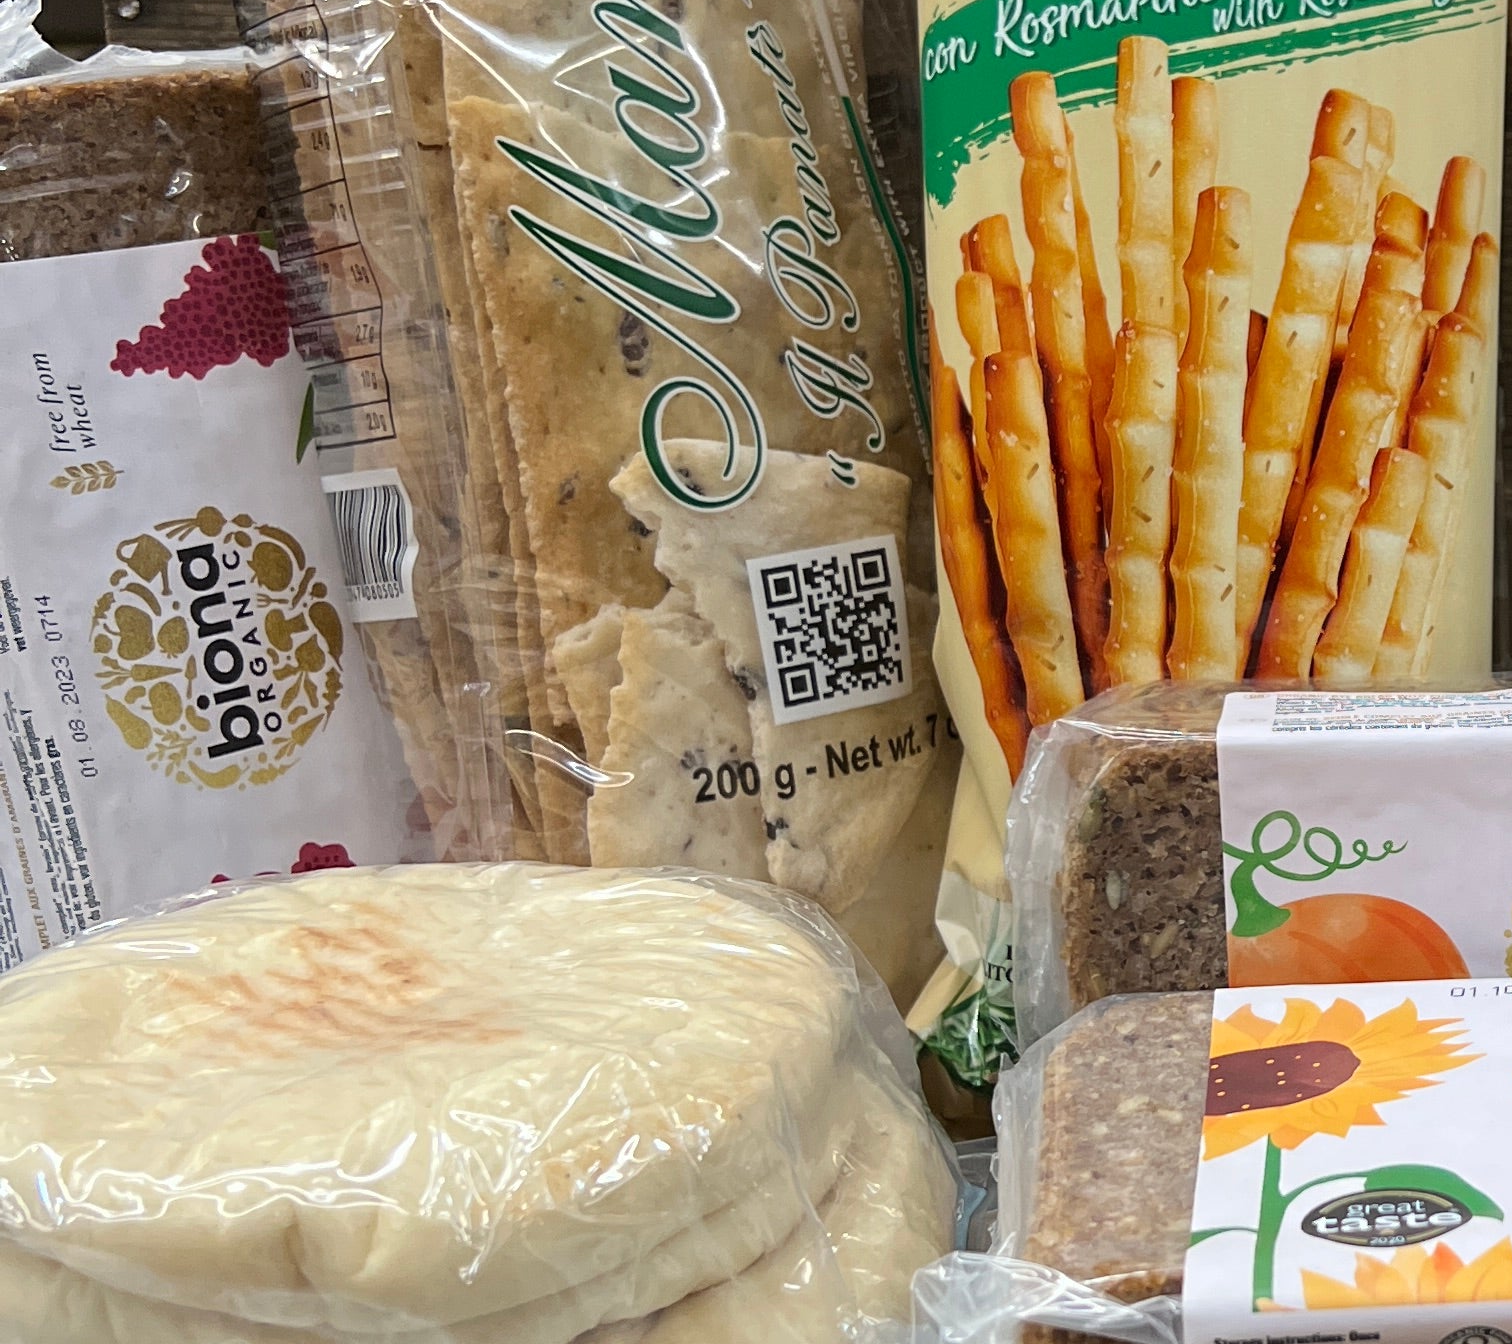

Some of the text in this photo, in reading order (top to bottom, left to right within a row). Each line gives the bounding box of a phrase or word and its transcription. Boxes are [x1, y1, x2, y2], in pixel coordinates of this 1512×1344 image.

[925, 34, 978, 83] con
[32, 352, 73, 454] free from
[65, 383, 97, 449] wheat
[38, 594, 64, 642] 0714
[178, 541, 264, 761] biona
[224, 550, 281, 734] ORGANIC
[692, 758, 761, 803] 200
[775, 764, 796, 801] g
[825, 733, 883, 779] Net
[888, 726, 923, 763] wt.
[1312, 1210, 1463, 1234] taste
[1346, 1199, 1426, 1218] great
